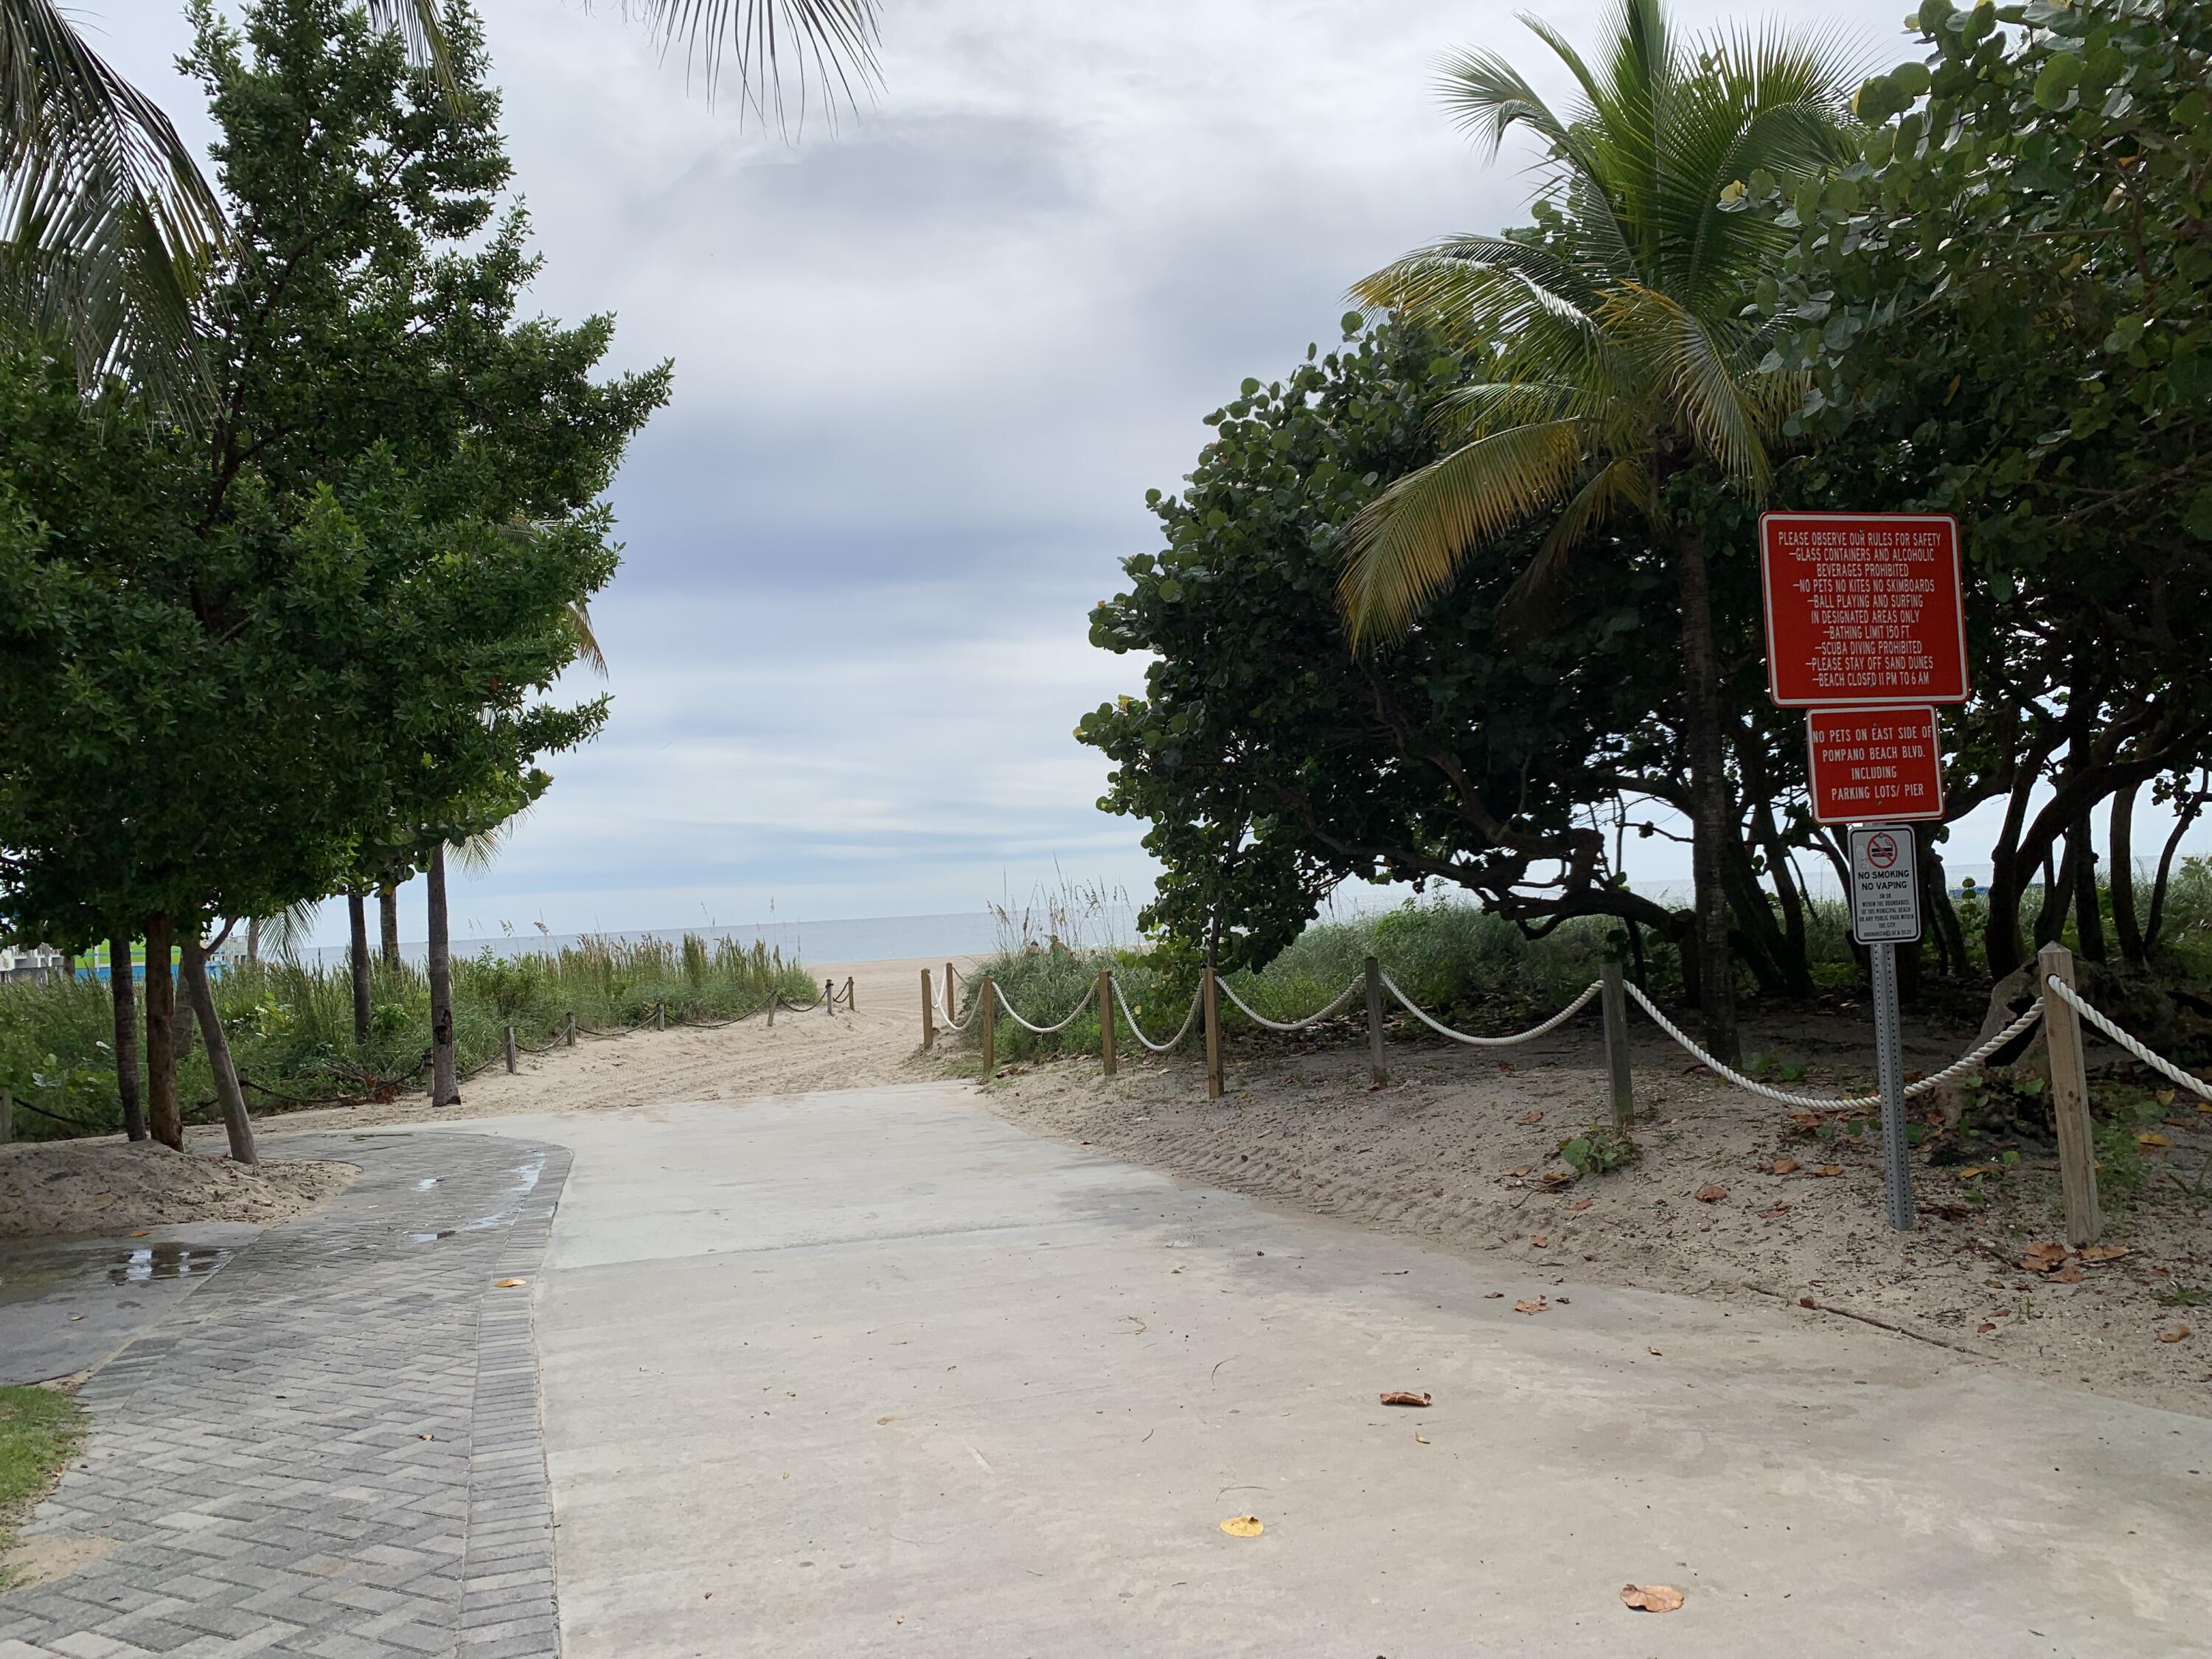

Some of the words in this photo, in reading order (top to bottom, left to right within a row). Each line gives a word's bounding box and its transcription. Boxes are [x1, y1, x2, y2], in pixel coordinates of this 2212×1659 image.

[1778, 532, 1809, 546] PLEASE
[1812, 532, 1847, 546] OBSERVE
[1849, 532, 1865, 546] OUR
[1868, 532, 1892, 546] RULES
[1895, 532, 1910, 546] FOR
[1913, 532, 1941, 546] SAFETY
[1824, 548, 1871, 561] CONTAINERS
[1874, 548, 1889, 561] AND
[1893, 548, 1935, 561] ALCOHOLIC
[1817, 563, 1862, 577] BEVERAGES
[1865, 563, 1908, 577] PROHIBITED
[1813, 579, 1832, 592] PETS
[1835, 579, 1846, 592] NO
[1848, 579, 1870, 592] KITES
[1874, 579, 1883, 592] NO
[1886, 579, 1935, 592] SKIMBOARDS
[1837, 594, 1869, 608] PLAYING
[1873, 594, 1888, 608] AND
[1891, 594, 1923, 608] SURFING
[1811, 610, 1819, 624] IN
[1822, 610, 1868, 624] DESIGNATED
[1872, 610, 1898, 623] AREAS
[1900, 610, 1919, 623] ONLY
[1865, 625, 1884, 639] LIMIT
[1887, 625, 1899, 639] 150
[1902, 625, 1911, 639] FT.
[1851, 641, 1876, 655] DIVING
[1878, 641, 1922, 654] PROHIBITED
[1845, 657, 1864, 670] STAY
[1868, 656, 1882, 670] OFF
[1885, 656, 1905, 669] SAND
[1908, 655, 1933, 669] DUNES
[1848, 672, 1877, 686] CLOSED
[1879, 672, 1885, 686] 11
[1886, 672, 1897, 685] PM
[1899, 672, 1909, 685] TO
[1912, 672, 1916, 685] 6
[1919, 671, 1929, 684] AM
[1812, 731, 1824, 743] NO
[1829, 729, 1851, 742] PETS
[1855, 728, 1867, 742] ON
[1872, 727, 1893, 740] EAST
[1898, 726, 1917, 739] SIDE
[1922, 726, 1932, 738] OF
[1823, 748, 1865, 762] POMPANO
[1869, 746, 1898, 760] BEACH
[1902, 745, 1926, 759] BLVD.
[1851, 765, 1897, 780] INCLUDING
[1832, 786, 1870, 801] PARKING
[1874, 785, 1900, 799] LOTS/
[1905, 783, 1924, 796] PIER
[1858, 872, 1870, 880] NO
[1872, 869, 1910, 879] SMOKING
[1862, 883, 1874, 891] NO
[1876, 881, 1907, 890] VAPING
